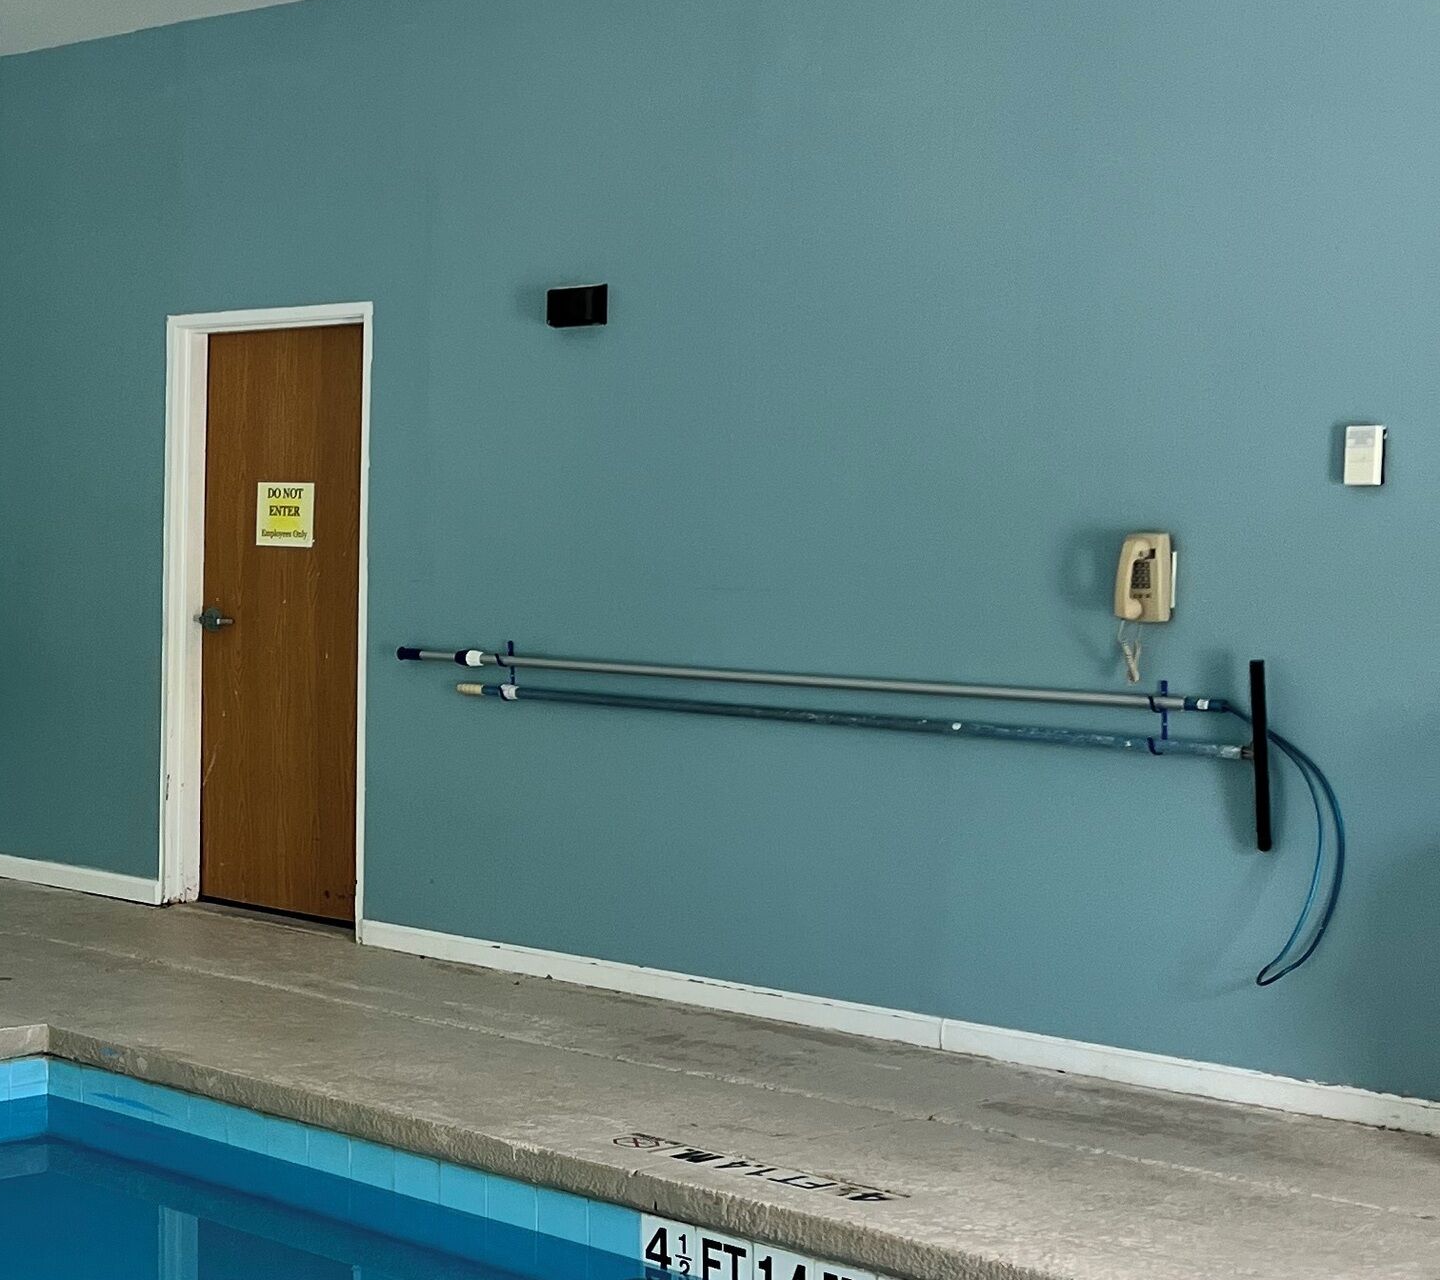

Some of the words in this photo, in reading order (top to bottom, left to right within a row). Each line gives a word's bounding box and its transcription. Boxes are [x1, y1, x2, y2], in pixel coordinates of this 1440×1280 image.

[268, 488, 281, 498] DO
[283, 488, 304, 499] NOT
[269, 506, 300, 516] ENTER
[293, 530, 307, 539] Only
